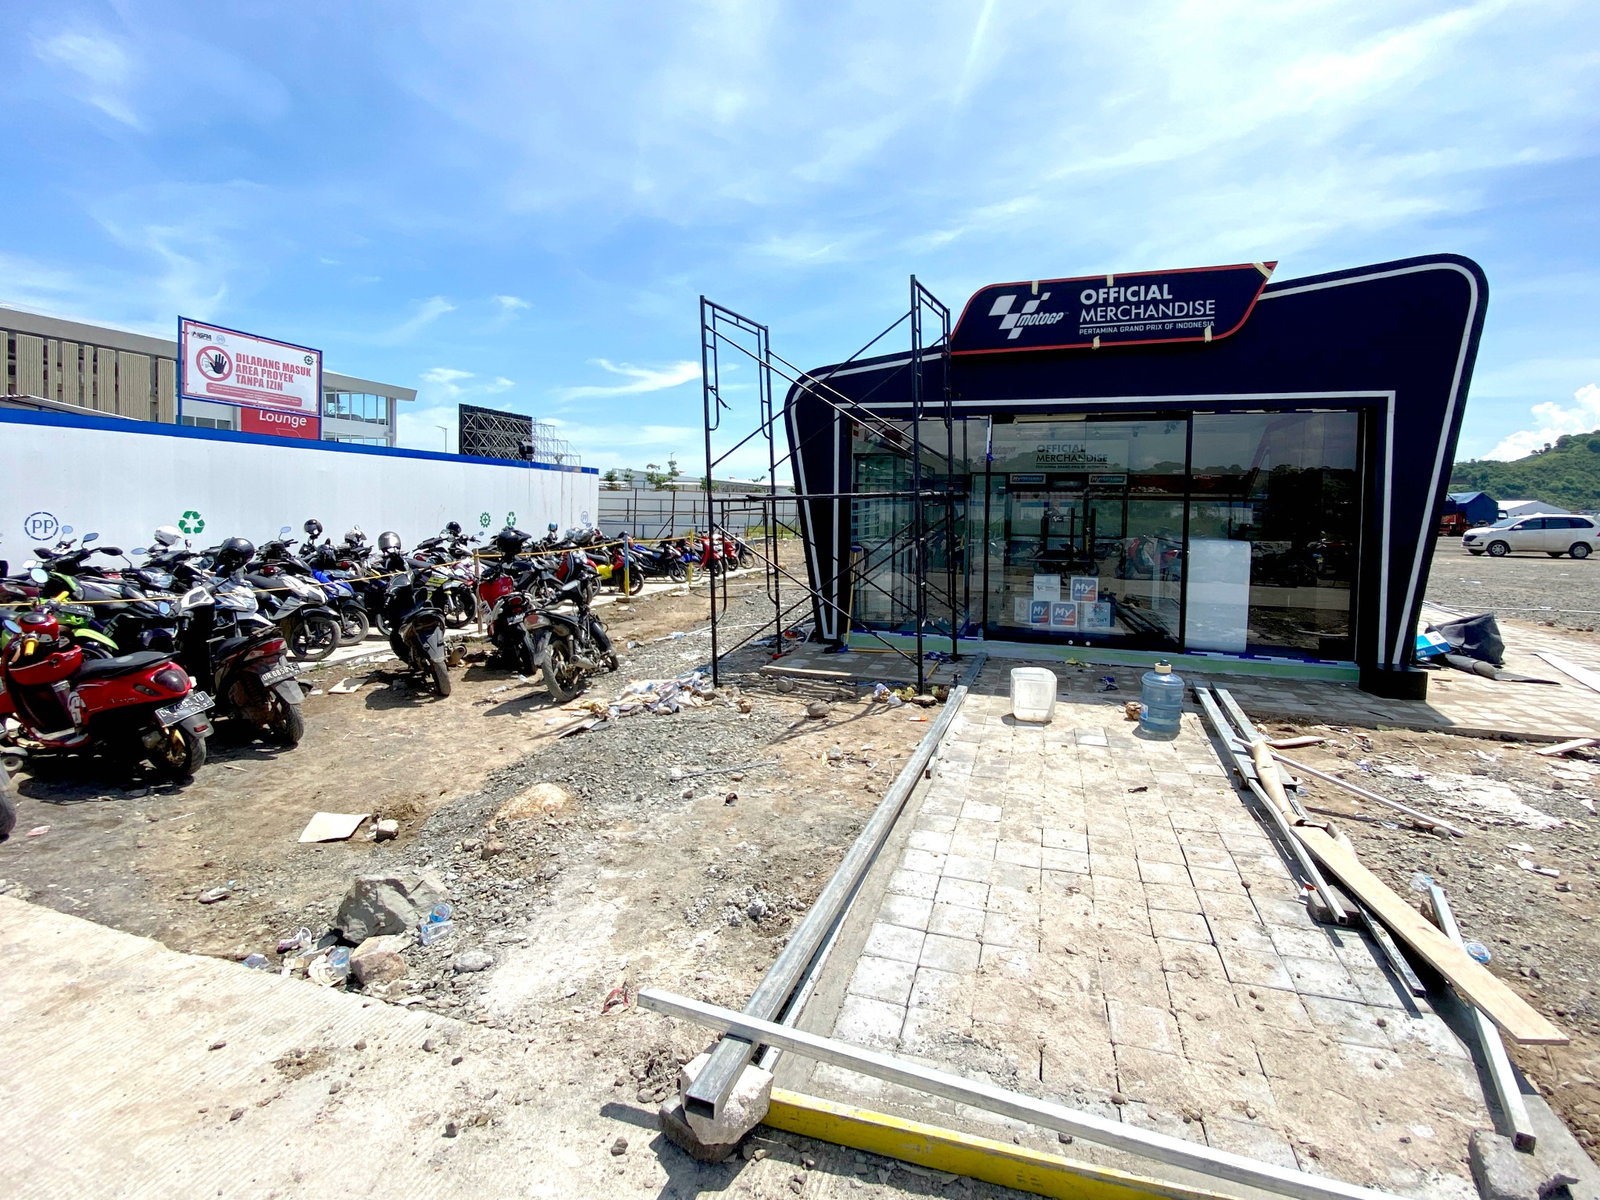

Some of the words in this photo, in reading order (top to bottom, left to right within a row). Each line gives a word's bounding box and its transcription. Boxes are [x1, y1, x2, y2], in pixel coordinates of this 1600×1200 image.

[1080, 284, 1173, 305] OFFICIAL
[1079, 300, 1216, 323] MERCHANDISE
[1079, 326, 1118, 336] PERTAMINA
[1119, 325, 1144, 333] GRAND
[1145, 323, 1163, 331] PRIX
[1164, 322, 1174, 330] OF
[1175, 320, 1215, 329] INDONESIA
[235, 353, 280, 370] DILARANG
[282, 363, 311, 377] MASUK
[235, 364, 258, 375] AREA
[261, 368, 294, 384] PROYEK
[235, 374, 264, 386] TANPA
[266, 380, 283, 391] IZIN
[259, 411, 307, 427] Lounge
[1036, 444, 1086, 453] OFFICIAL
[1036, 453, 1108, 462] MERCHANDISE
[32, 519, 54, 534] PP
[1075, 583, 1094, 593] My
[1033, 606, 1048, 615] My
[1055, 607, 1074, 617] My
